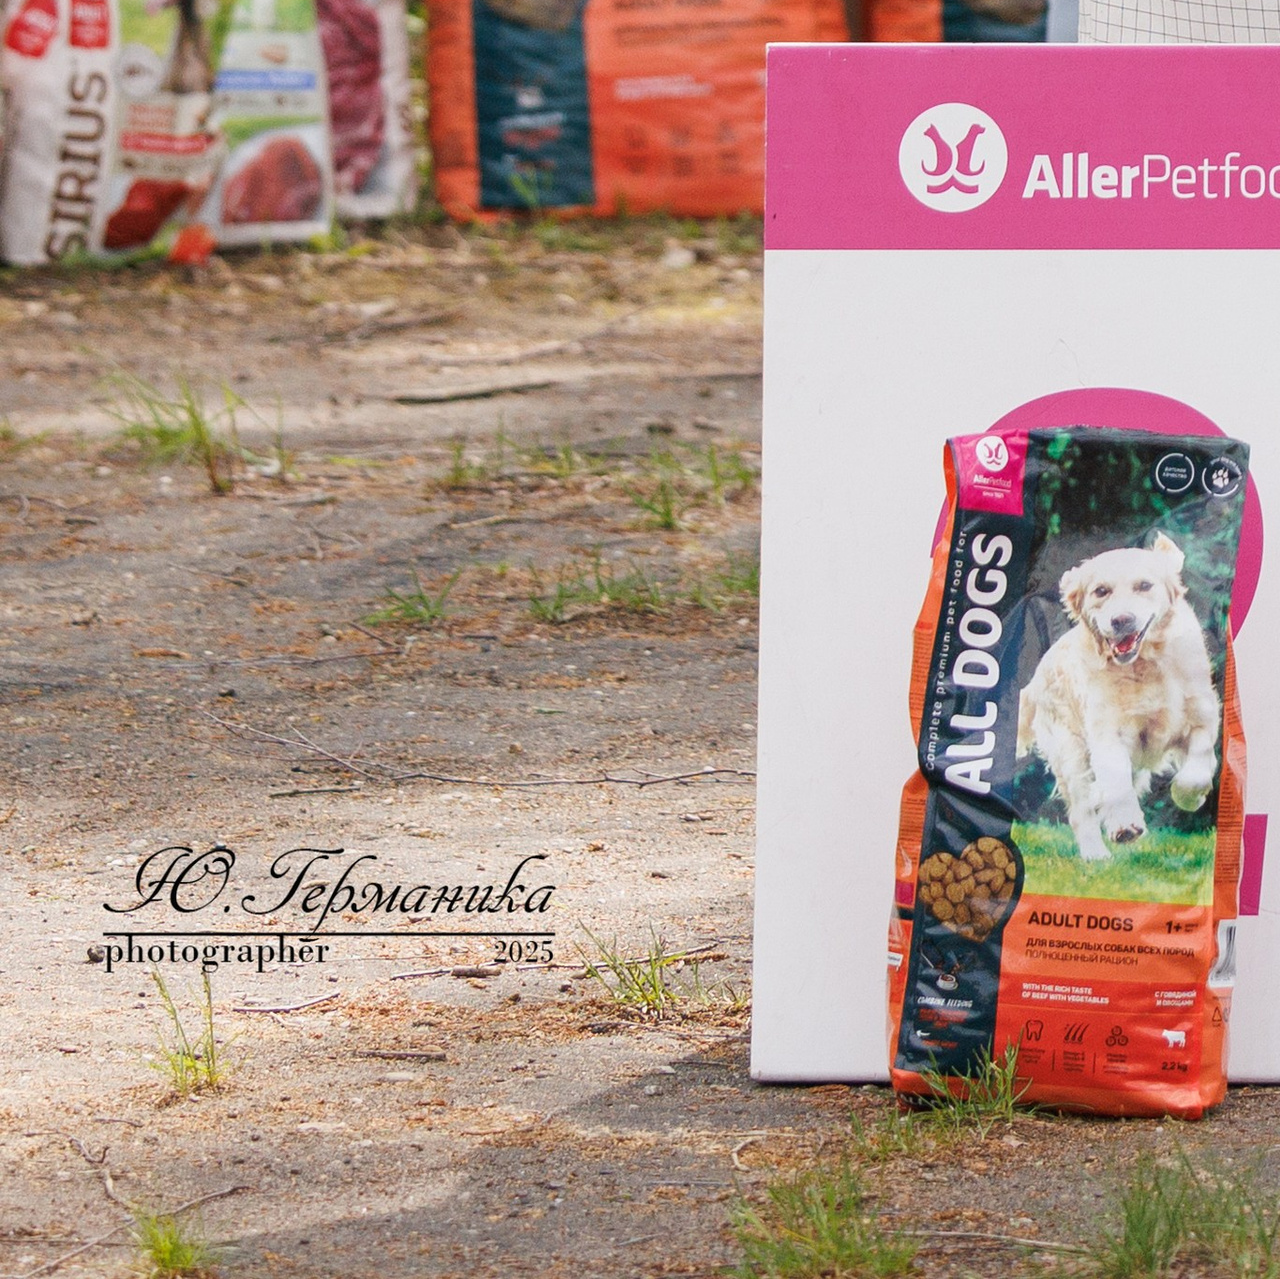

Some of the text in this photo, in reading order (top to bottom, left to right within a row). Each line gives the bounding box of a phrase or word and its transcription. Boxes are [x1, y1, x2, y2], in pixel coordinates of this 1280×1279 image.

[44, 69, 108, 260] SIRIUS
[957, 530, 967, 555] for
[950, 558, 964, 594] food
[946, 600, 958, 625] pet
[935, 631, 952, 696] premium
[944, 532, 1014, 795] ALL DOGS
[1027, 911, 1134, 932] ADULT DOGS
[1165, 921, 1183, 934] 1+
[1025, 949, 1139, 966] ПОЛНОЦЕННЫЙ РАЦИОН
[1026, 937, 1047, 948] ДЛЯ
[1048, 939, 1103, 952] ВЗРОСЛЫХ
[1103, 943, 1136, 954] СОБАК
[1137, 945, 1161, 956] ВСЕХ
[1022, 982, 1093, 995] WITH THE RICH TASTE
[1068, 995, 1109, 1004] VEGETABLES
